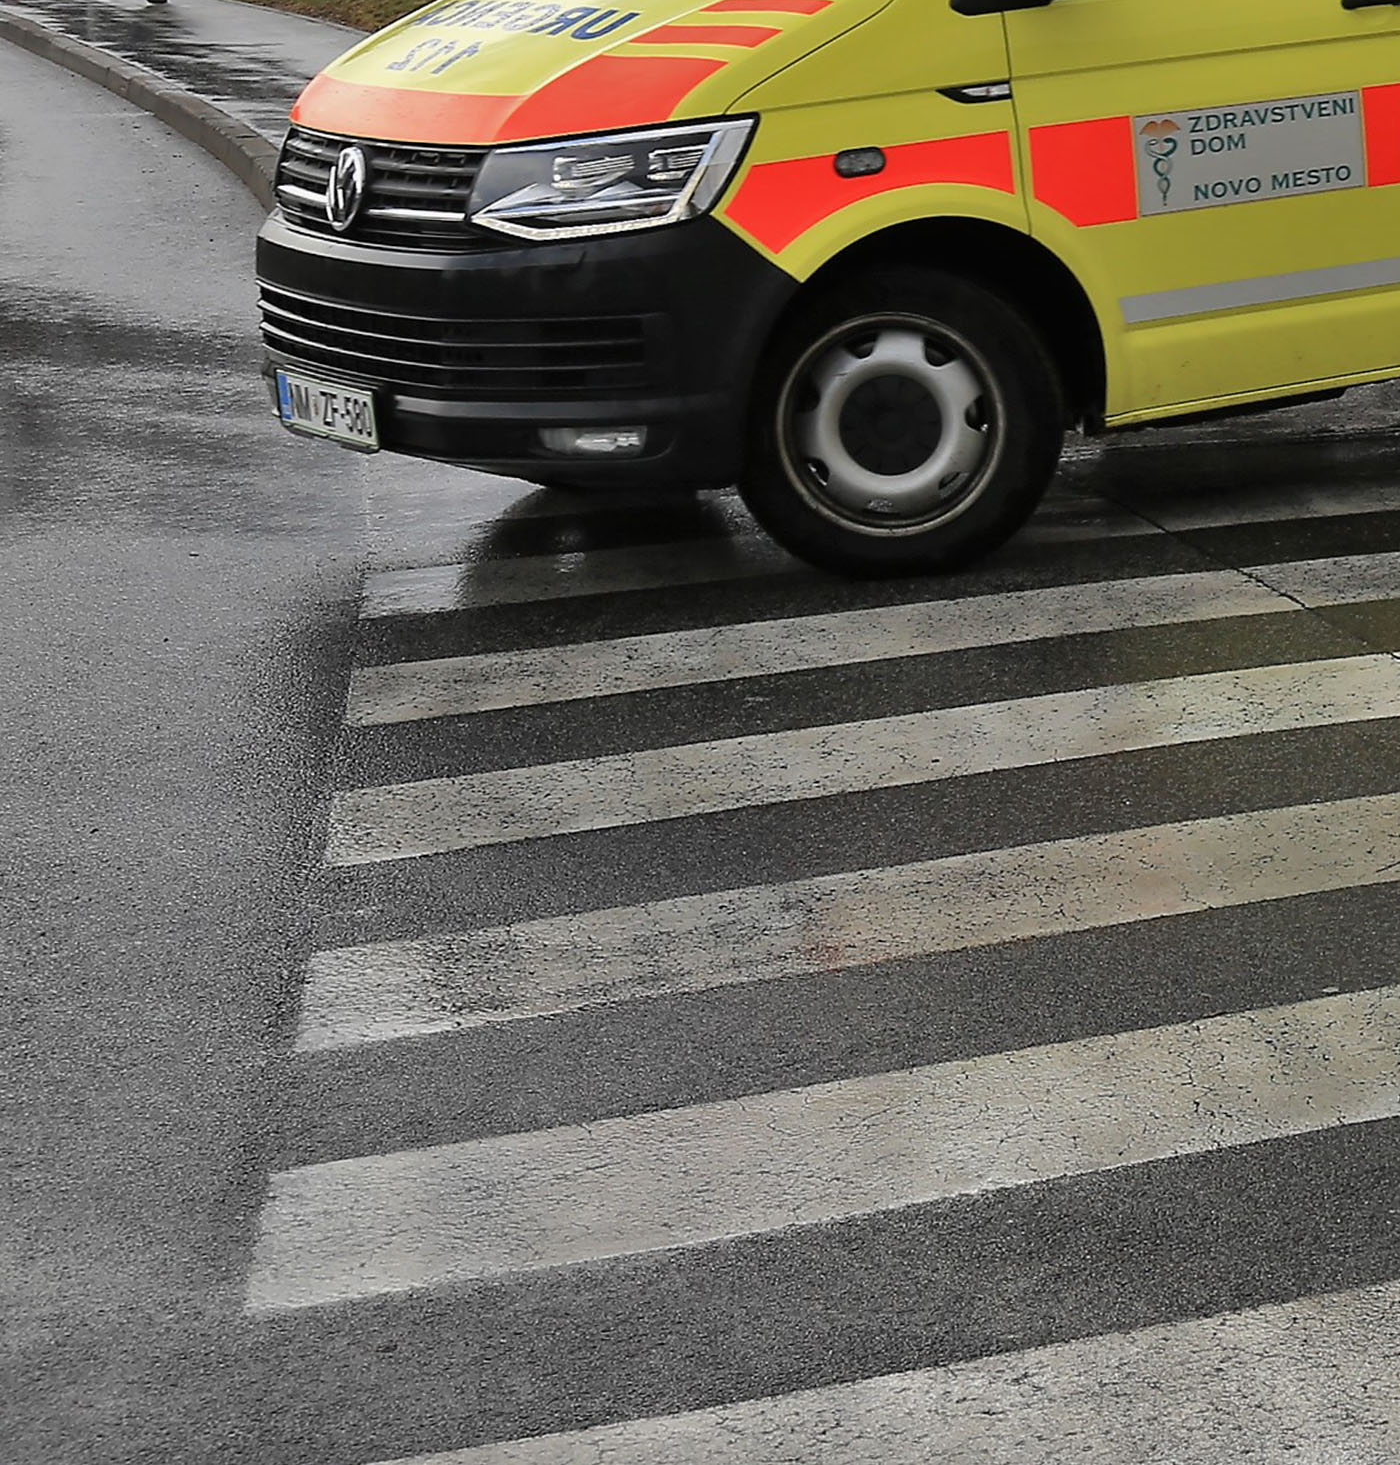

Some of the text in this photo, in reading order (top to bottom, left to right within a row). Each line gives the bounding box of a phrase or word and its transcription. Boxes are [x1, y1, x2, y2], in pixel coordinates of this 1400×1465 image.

[1187, 97, 1355, 134] ZDRAVSTVENI
[1190, 133, 1247, 156] DOM
[1194, 164, 1352, 202] NOVO MESTO
